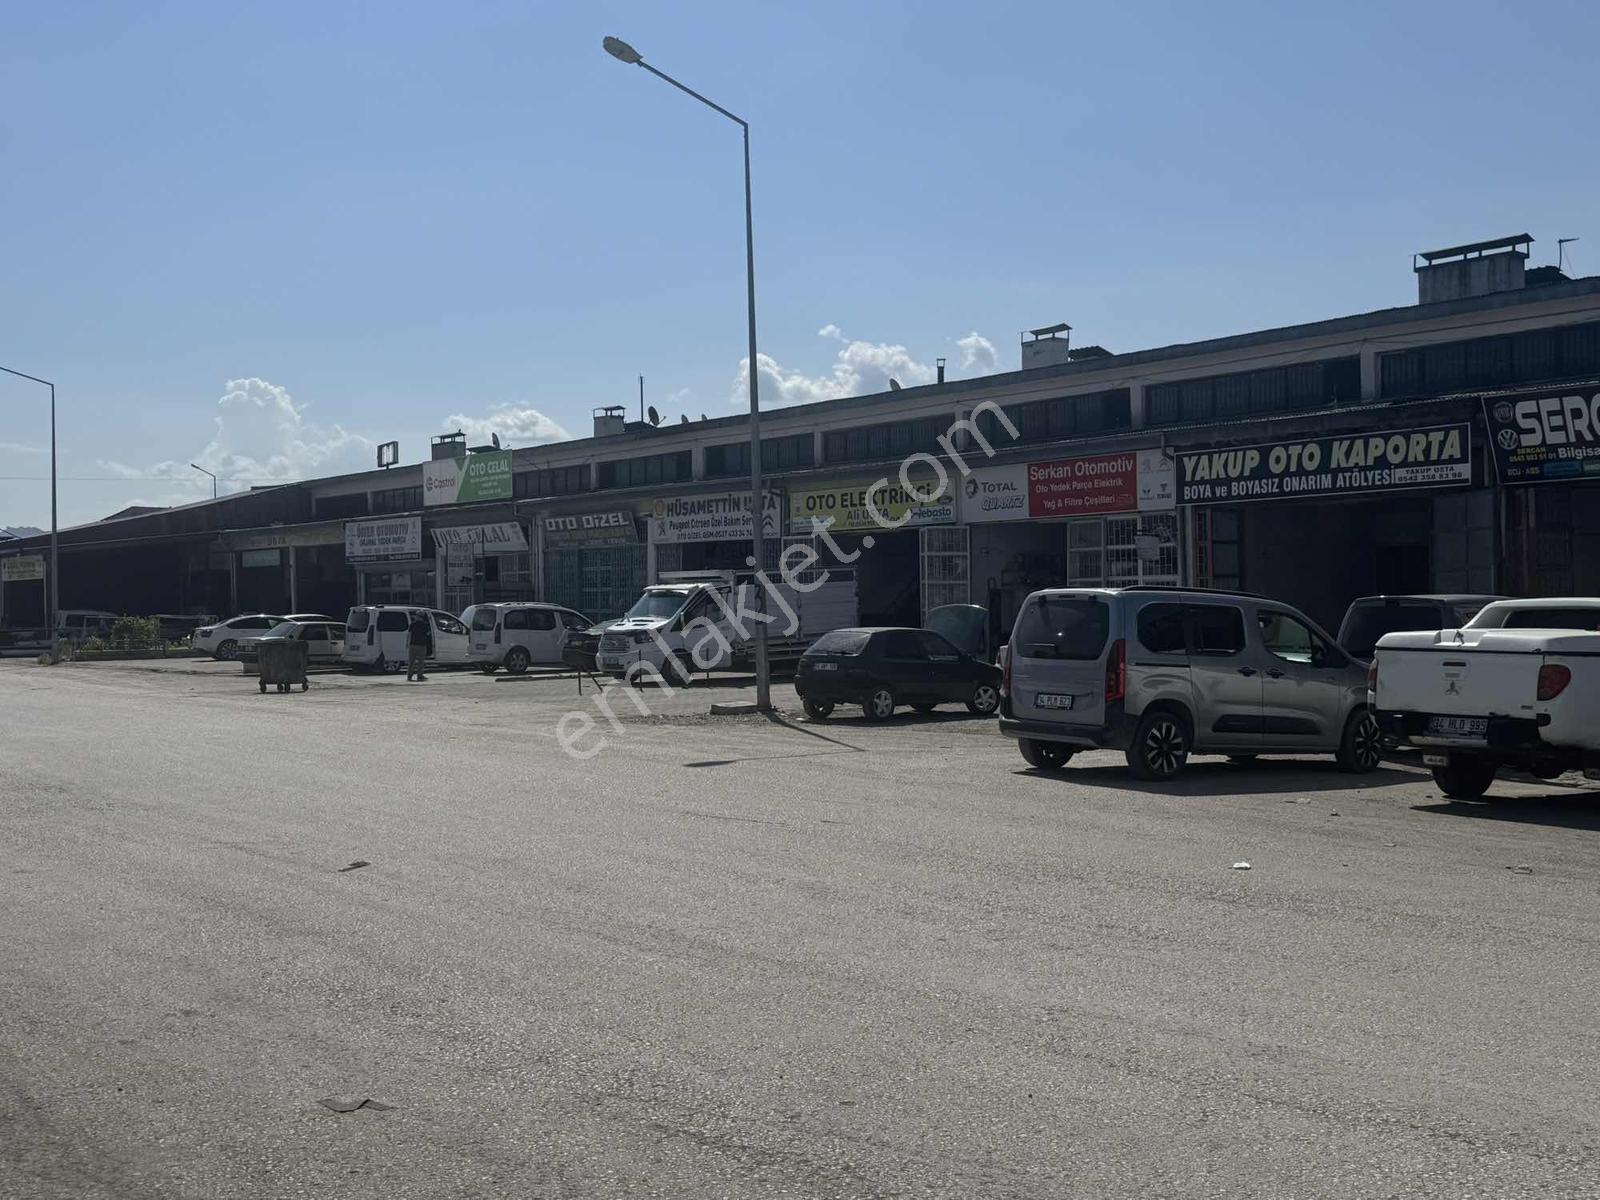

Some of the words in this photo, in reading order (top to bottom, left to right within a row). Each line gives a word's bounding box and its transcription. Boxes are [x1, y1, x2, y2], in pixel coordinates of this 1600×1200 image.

[1182, 449, 1260, 481] YAKUP
[1268, 442, 1321, 474] OTO
[1330, 429, 1461, 468] KAPORTA
[470, 462, 486, 476] OTO
[487, 459, 509, 474] CELAL
[1030, 465, 1071, 480] Serkan
[1074, 457, 1134, 476] Otomotiv
[1036, 485, 1048, 493] Oto
[1050, 483, 1071, 492] Yedek
[1072, 481, 1093, 491] Parça
[1094, 478, 1123, 489] Elektrik
[1183, 484, 1212, 500] BOYA
[1215, 486, 1228, 497] ve
[1231, 478, 1280, 496] BOYASIZ
[1283, 473, 1332, 492] ONARIM
[1336, 466, 1395, 488] ATÖLYESİ
[667, 493, 740, 517] HÜSAMETTİN
[806, 493, 836, 511] OTO
[545, 518, 577, 531] OTO
[582, 511, 629, 528] DİZEL
[847, 510, 861, 521] Ali
